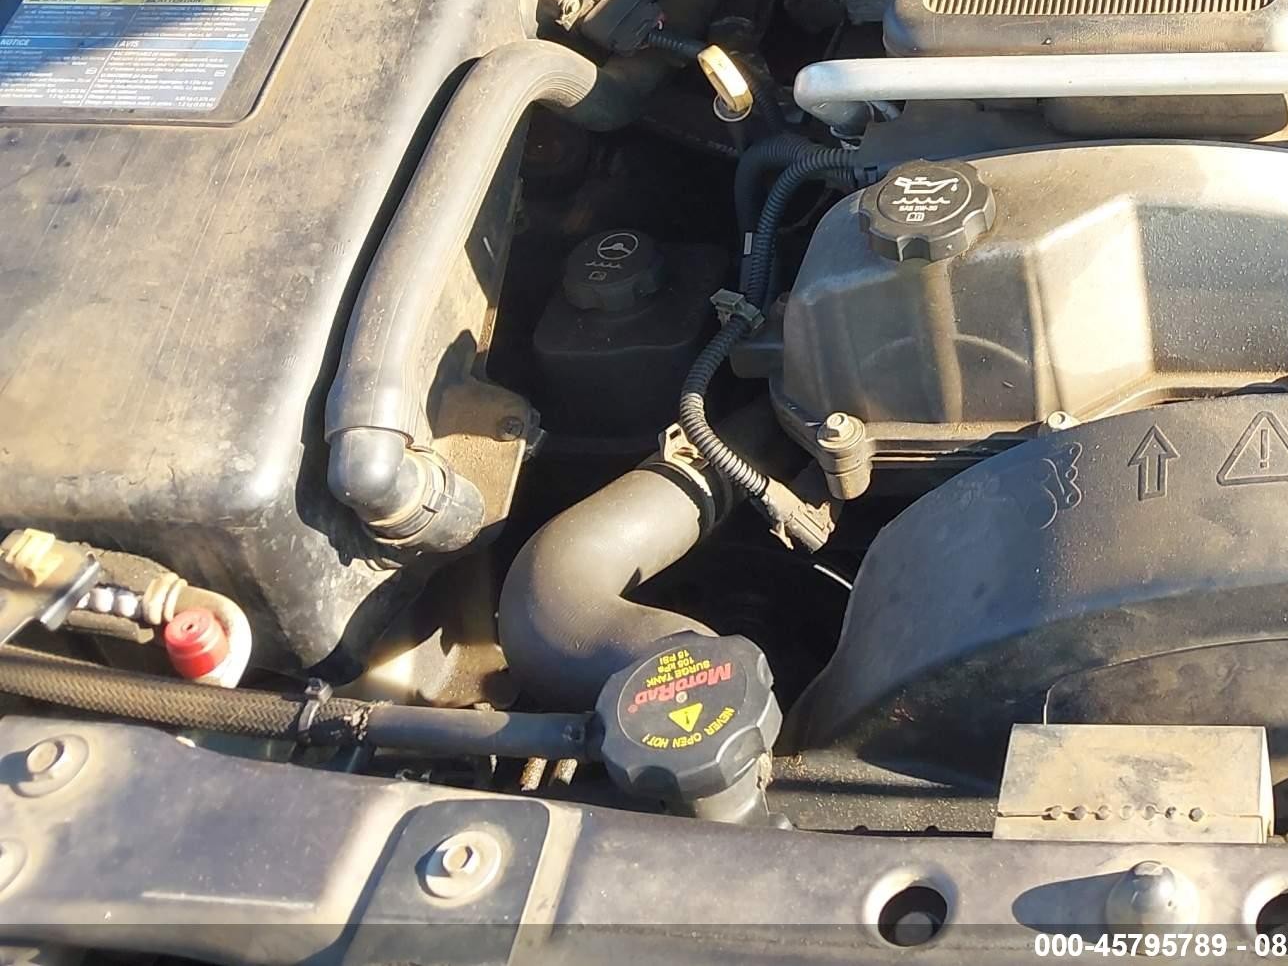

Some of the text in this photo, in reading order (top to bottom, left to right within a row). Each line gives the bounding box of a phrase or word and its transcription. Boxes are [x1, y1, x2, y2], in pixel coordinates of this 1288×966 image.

[0, 38, 30, 46] NOTICE
[119, 40, 139, 48] AVIS
[657, 657, 694, 674] 105 kPa
[659, 653, 676, 665] PSI
[646, 660, 710, 688] SURGE TANK
[703, 707, 736, 736] NEVER
[672, 732, 703, 748] OPEN
